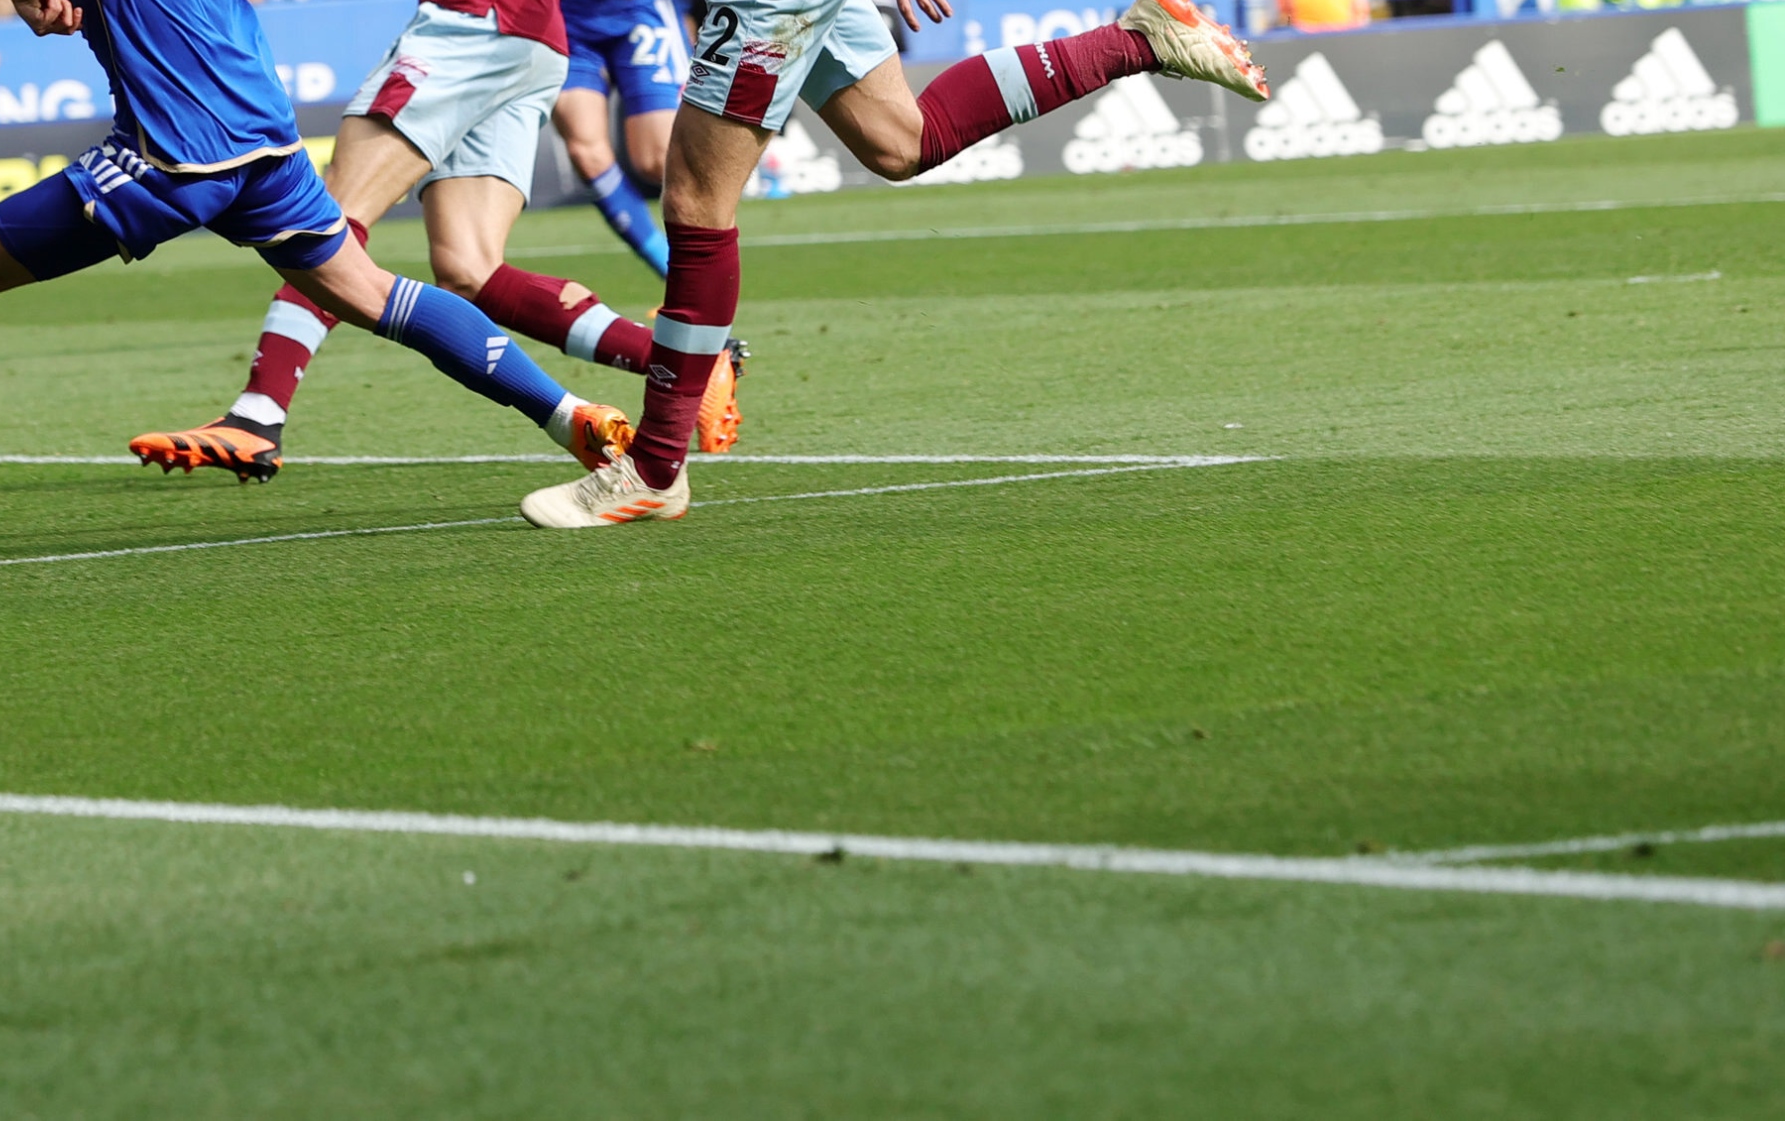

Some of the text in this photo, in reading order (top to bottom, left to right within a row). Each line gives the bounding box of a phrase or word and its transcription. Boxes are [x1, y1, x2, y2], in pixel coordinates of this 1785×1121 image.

[628, 23, 669, 67] 27
[1421, 101, 1564, 150] adidas
[1599, 89, 1740, 137] adidas
[1062, 127, 1204, 175] adidas
[1243, 114, 1386, 163] adidas
